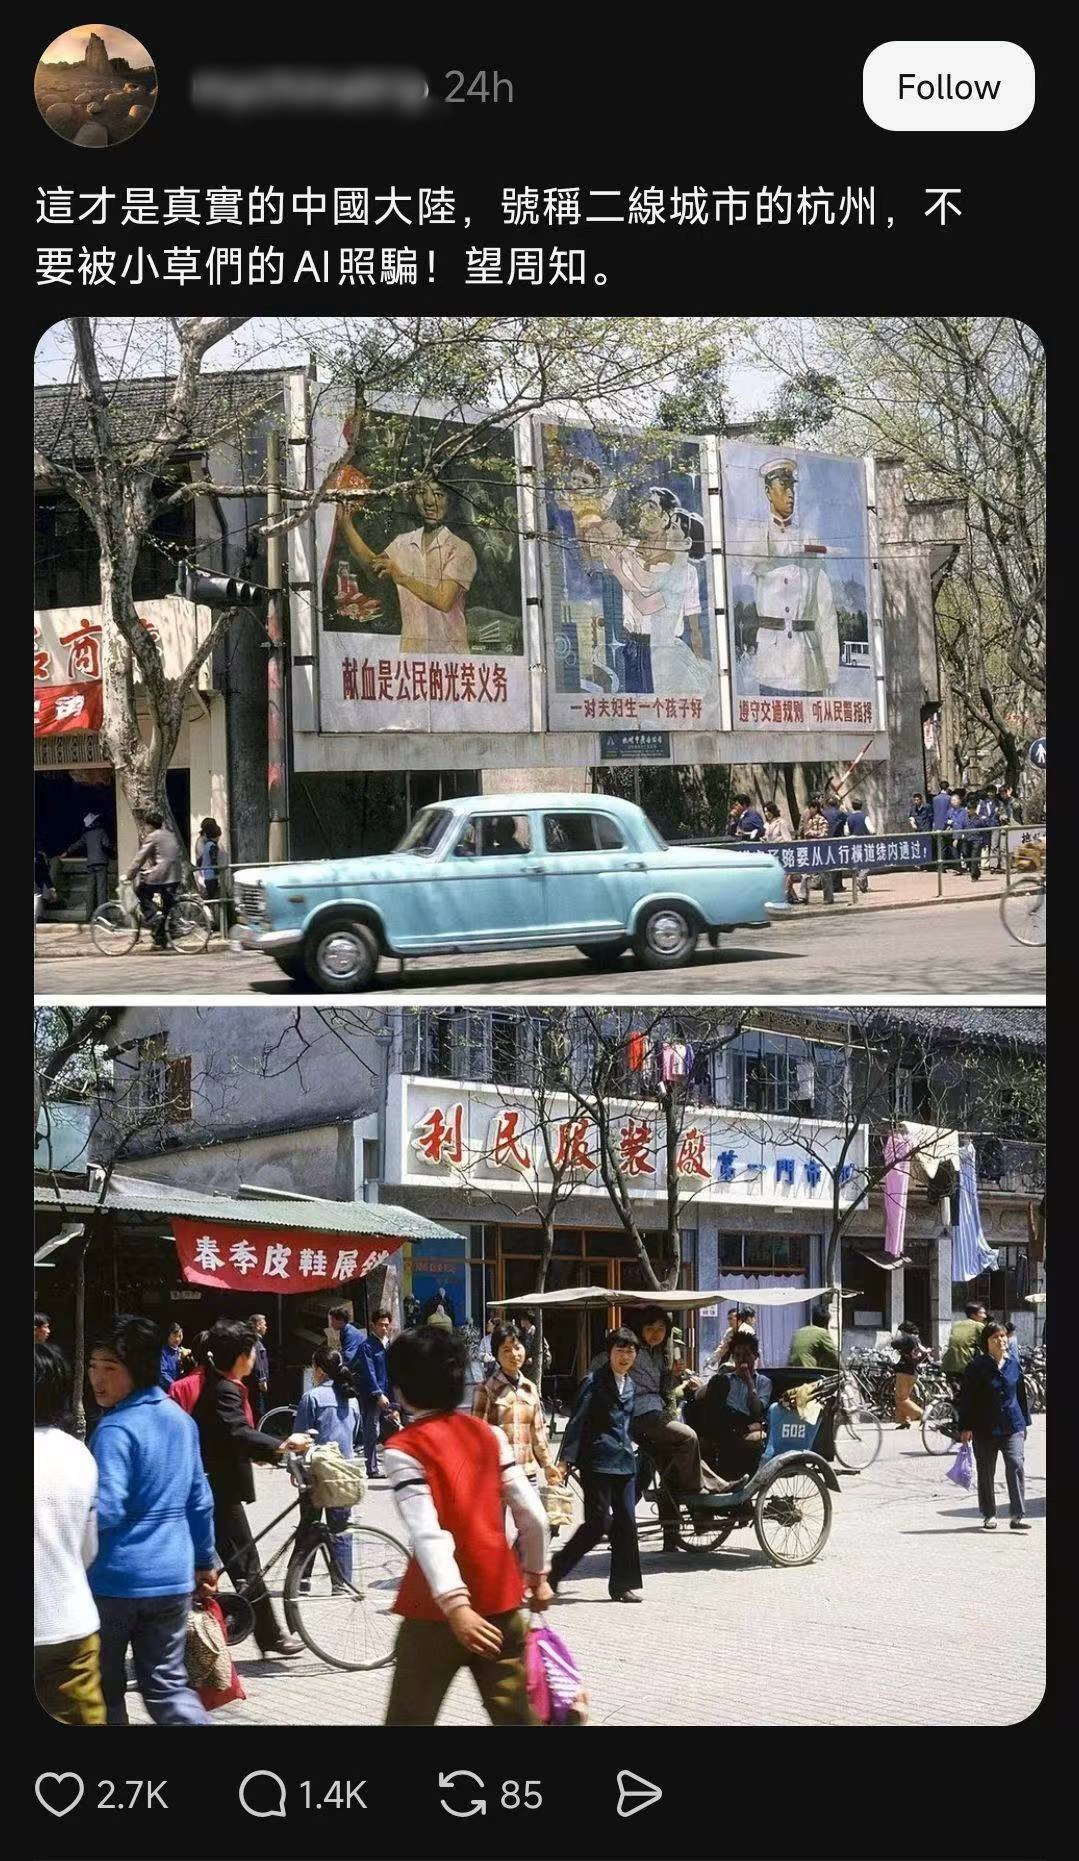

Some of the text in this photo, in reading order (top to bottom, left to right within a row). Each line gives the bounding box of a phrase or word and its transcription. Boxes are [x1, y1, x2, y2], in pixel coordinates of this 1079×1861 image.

[342, 656, 508, 702] 献血是公民的光荣义务
[570, 697, 702, 718] 一对夫妇生一个孩子好
[739, 699, 872, 724] 遵守交通规则 听从民警指挥
[739, 840, 928, 868] 路要从人行横道线内通过！
